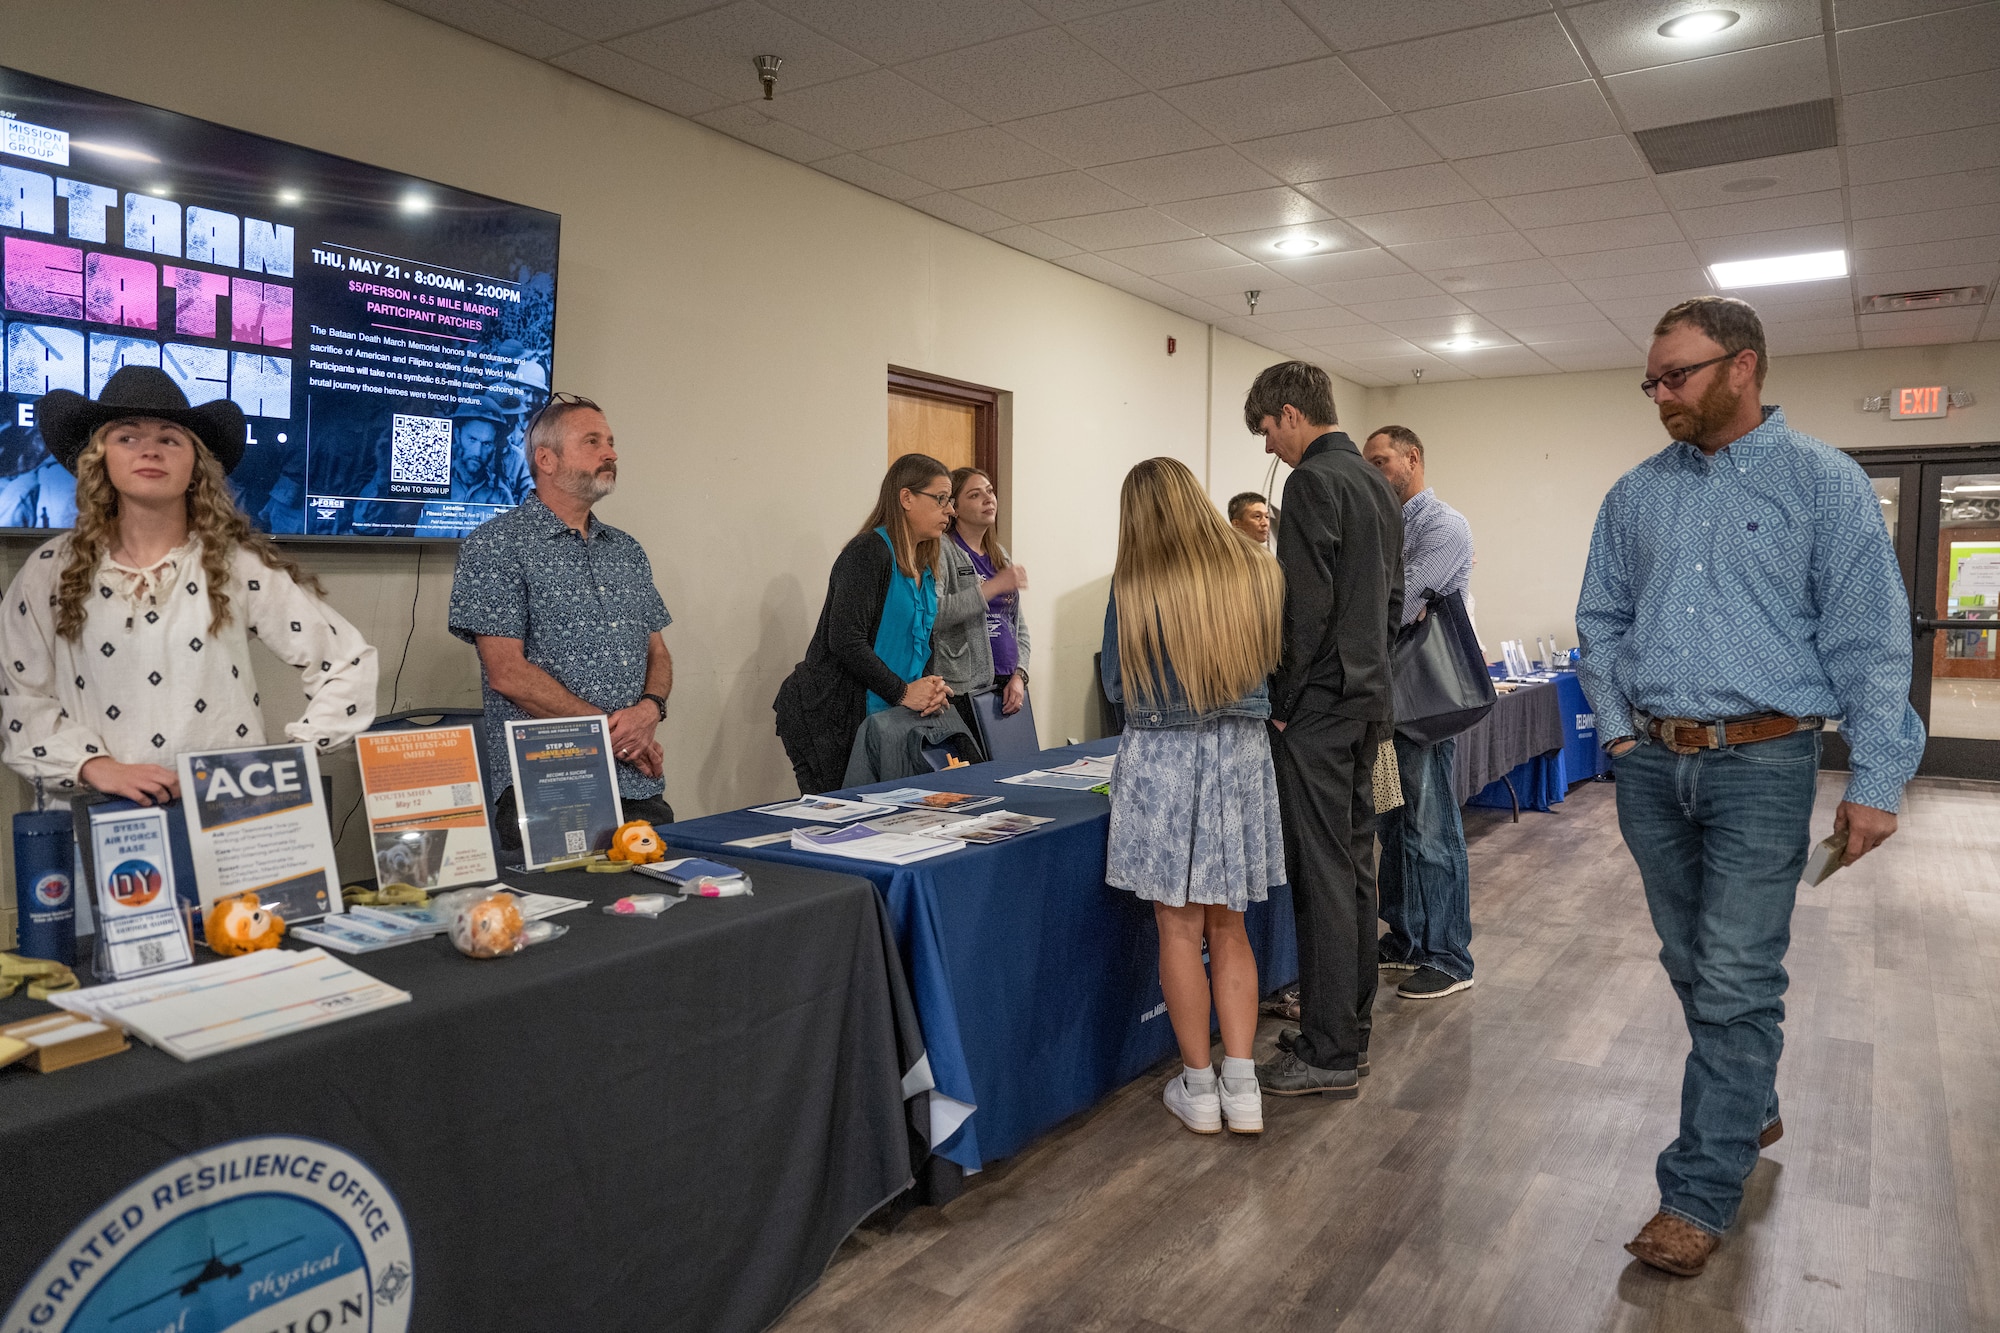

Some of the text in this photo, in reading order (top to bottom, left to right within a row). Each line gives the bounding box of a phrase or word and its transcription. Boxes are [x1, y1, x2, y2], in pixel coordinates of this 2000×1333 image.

[9, 123, 62, 143] MISSION
[9, 133, 67, 153] CRITICAL
[9, 142, 54, 158] GROUP
[311, 248, 346, 271] THU,
[348, 256, 382, 276] MAY
[384, 264, 400, 280] 21
[414, 270, 465, 293] 8:00AM
[475, 282, 521, 304] 2:00PM
[348, 279, 499, 318] $5/PERSON 6.5 MILE MARCH
[367, 301, 483, 331] PARTICIPANT PATCHES
[310, 324, 526, 366] The Bataan Death March Memorial honors the endurance and
[310, 343, 343, 355] sacrifice
[344, 347, 354, 357] of
[354, 349, 391, 362] American
[392, 355, 407, 364] and
[408, 356, 434, 368] Filipino
[434, 361, 462, 372] soldiers
[462, 365, 484, 376] during
[484, 367, 504, 378] World
[309, 359, 356, 374] Participants
[356, 366, 369, 376] will
[369, 368, 386, 378] take
[386, 371, 397, 379] on
[403, 374, 434, 385] symbolic
[434, 376, 462, 388] 6.5-mile
[309, 376, 332, 388] brutal
[332, 379, 362, 393] journey
[362, 384, 383, 394] those
[383, 386, 409, 397] heroes
[409, 389, 427, 399] were
[427, 391, 450, 402] forced
[457, 396, 483, 406] endure.
[1900, 386, 1942, 414] EXIT
[390, 484, 450, 495] SCAN TO SIGN UP
[368, 730, 462, 746] FREE YOUTH MENTAL
[376, 738, 458, 754] HEALTH FIRST-AID
[545, 741, 577, 751] STEP UP.
[402, 749, 436, 760] (MHFA)
[540, 749, 559, 757] SAVE
[204, 759, 302, 802] ACE
[538, 773, 594, 784] PREVENTION FACILITATOR
[373, 788, 433, 802] YOUTH MHFA
[395, 798, 422, 809] May 12
[112, 821, 147, 834] DYESS
[104, 831, 159, 846] AIR FORCE
[118, 843, 147, 855] BASE
[215, 848, 232, 856] Care
[112, 868, 152, 900] DY
[17, 1153, 391, 1333] GRATED RESILIENCE OFFICE
[247, 1242, 345, 1302] Physical
